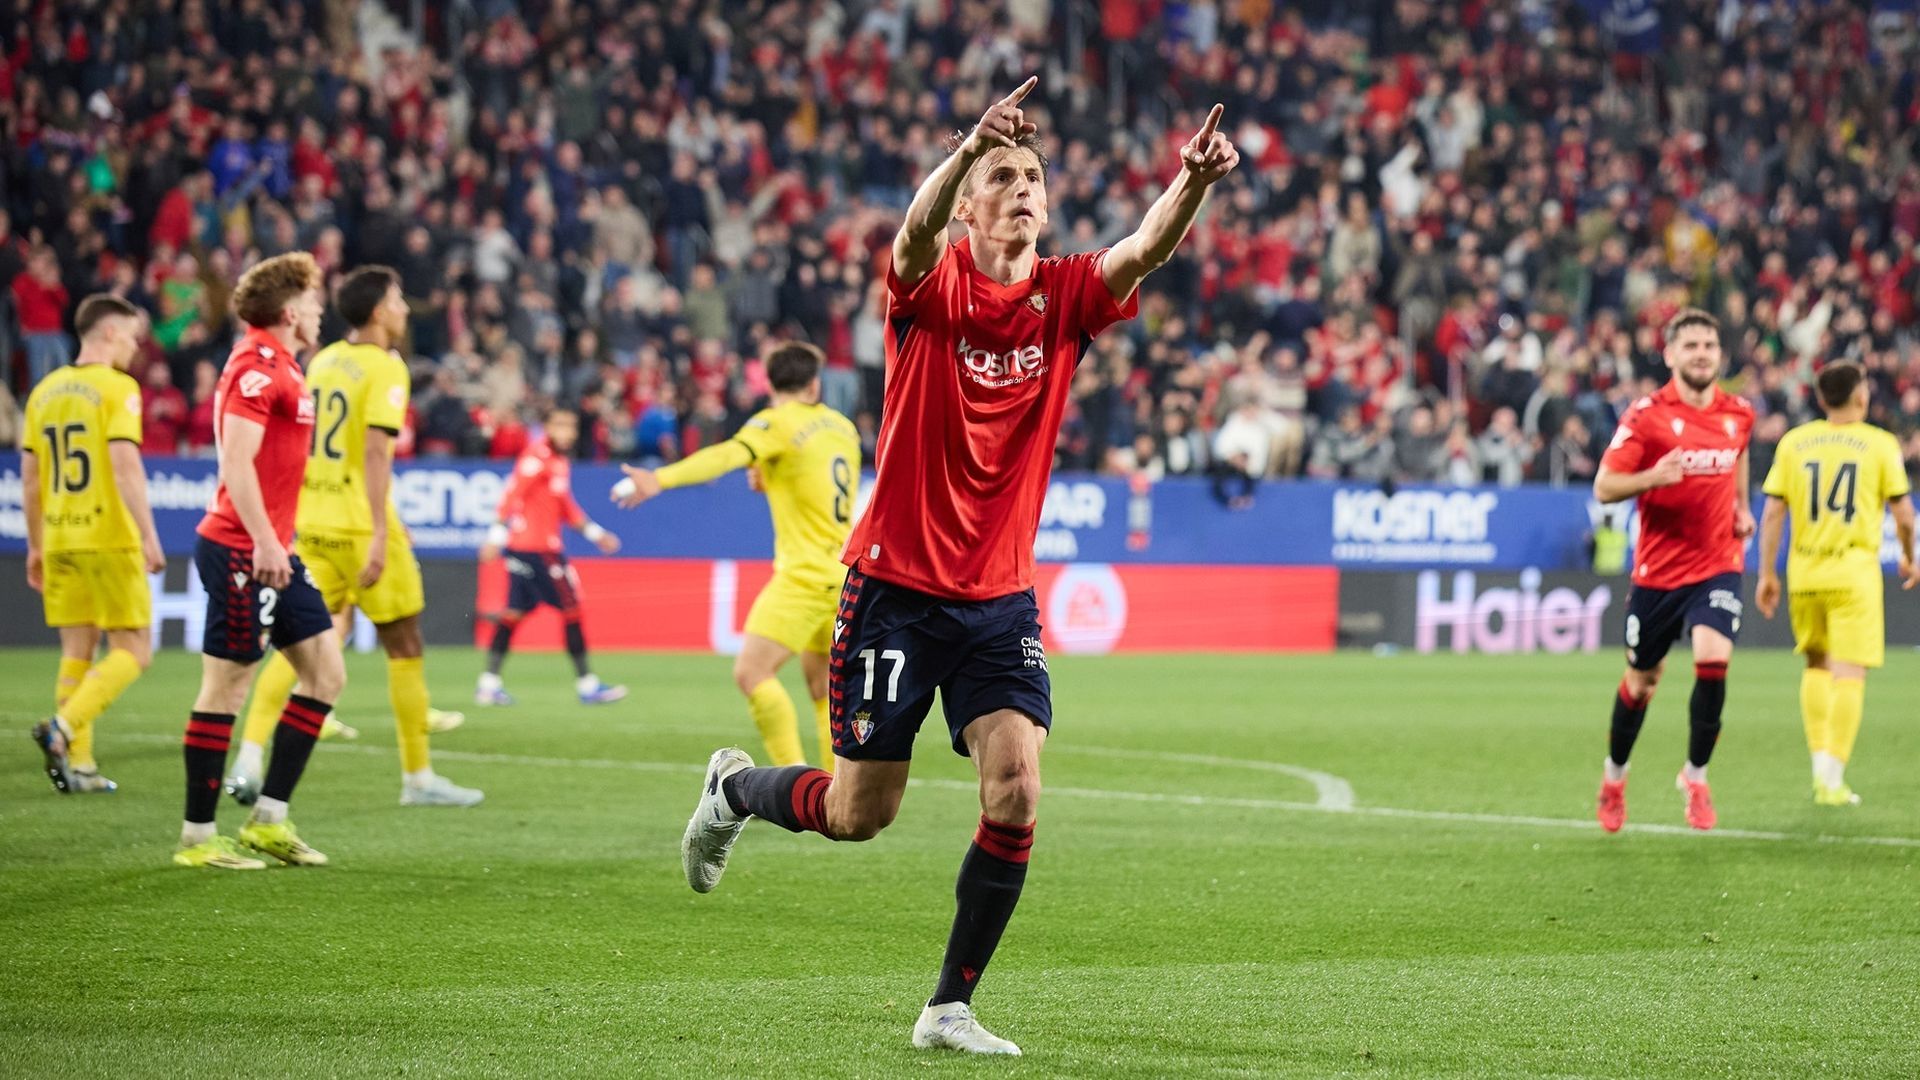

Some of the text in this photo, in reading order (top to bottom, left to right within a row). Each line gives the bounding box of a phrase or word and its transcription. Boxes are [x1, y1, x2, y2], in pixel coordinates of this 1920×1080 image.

[310, 388, 348, 460] 12
[43, 424, 91, 494] 15
[832, 457, 851, 523] 8
[1804, 461, 1857, 524] 14
[258, 587, 278, 626] 2
[1415, 566, 1612, 655] Haier
[858, 648, 906, 703] 17
[1023, 658, 1038, 669] de
